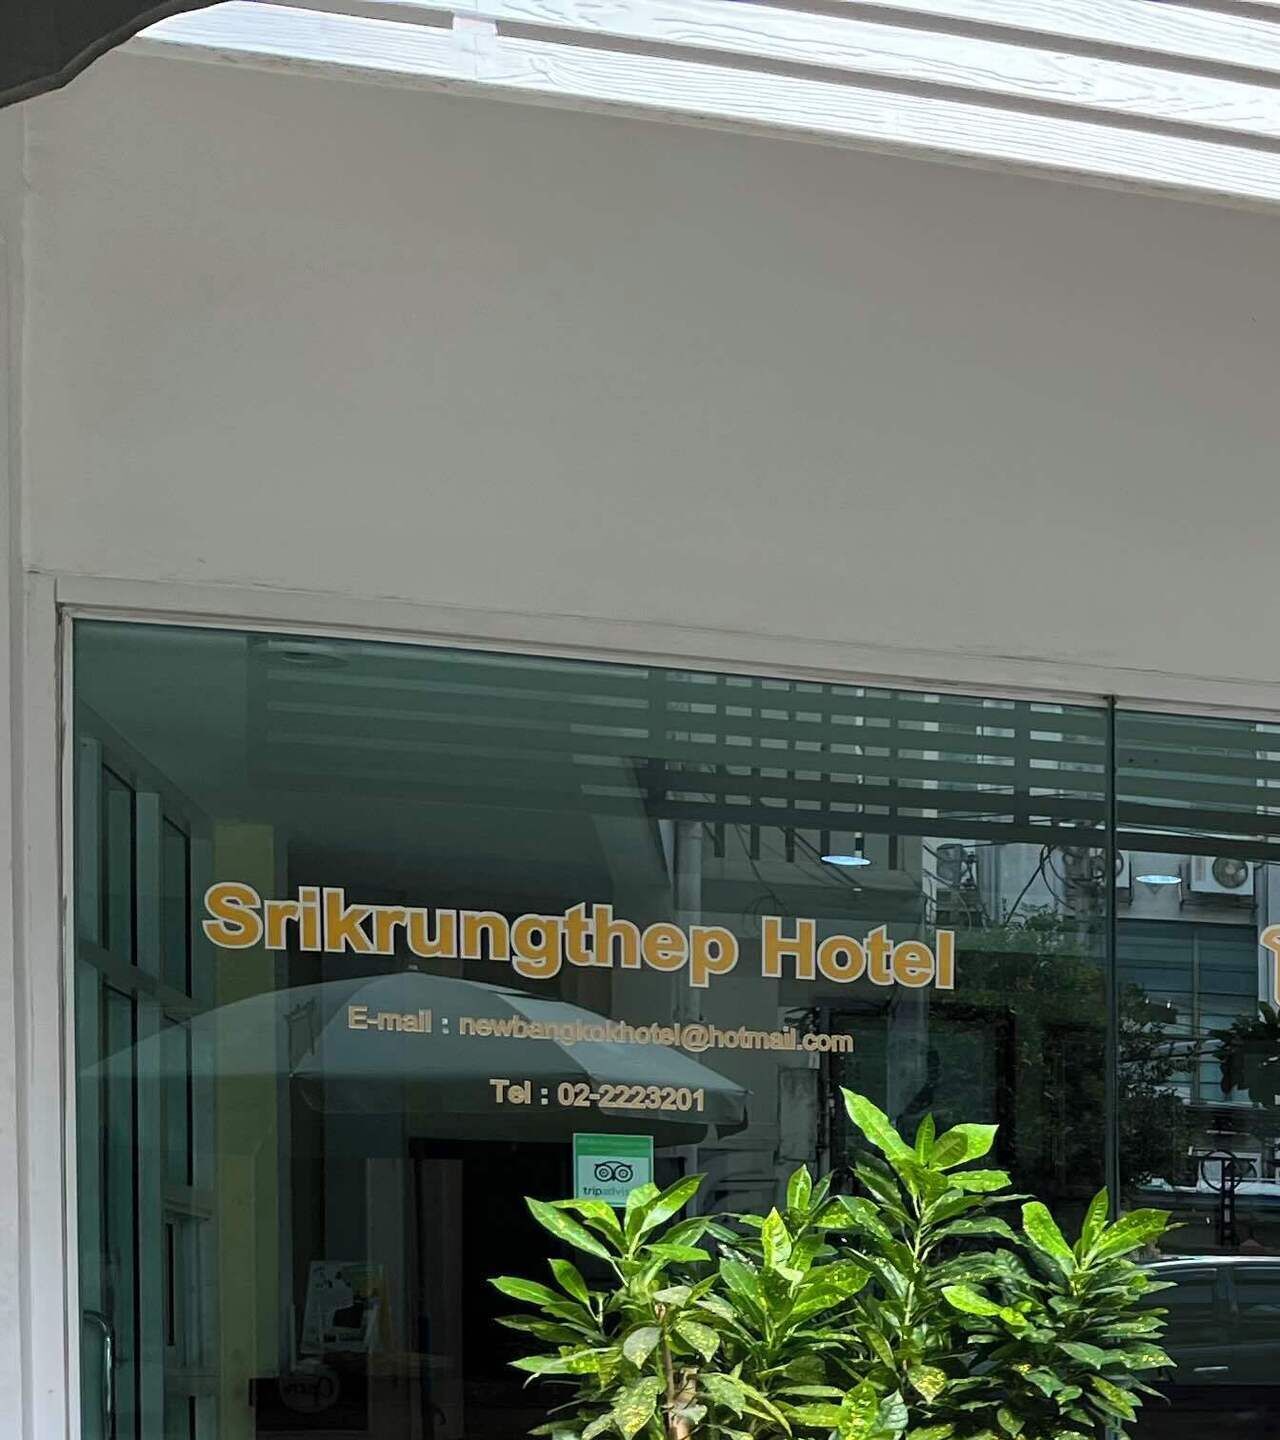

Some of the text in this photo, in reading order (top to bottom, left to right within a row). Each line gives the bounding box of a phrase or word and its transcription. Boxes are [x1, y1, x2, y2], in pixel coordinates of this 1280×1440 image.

[202, 881, 955, 990] Srikrungthep Hotel
[348, 1005, 432, 1033] E-mail
[459, 1015, 854, 1053] newbangkokhotel@hotmail.com
[489, 1079, 532, 1105] Tel
[557, 1082, 705, 1112] 02-2223201
[583, 1186, 630, 1197] tripadvi
